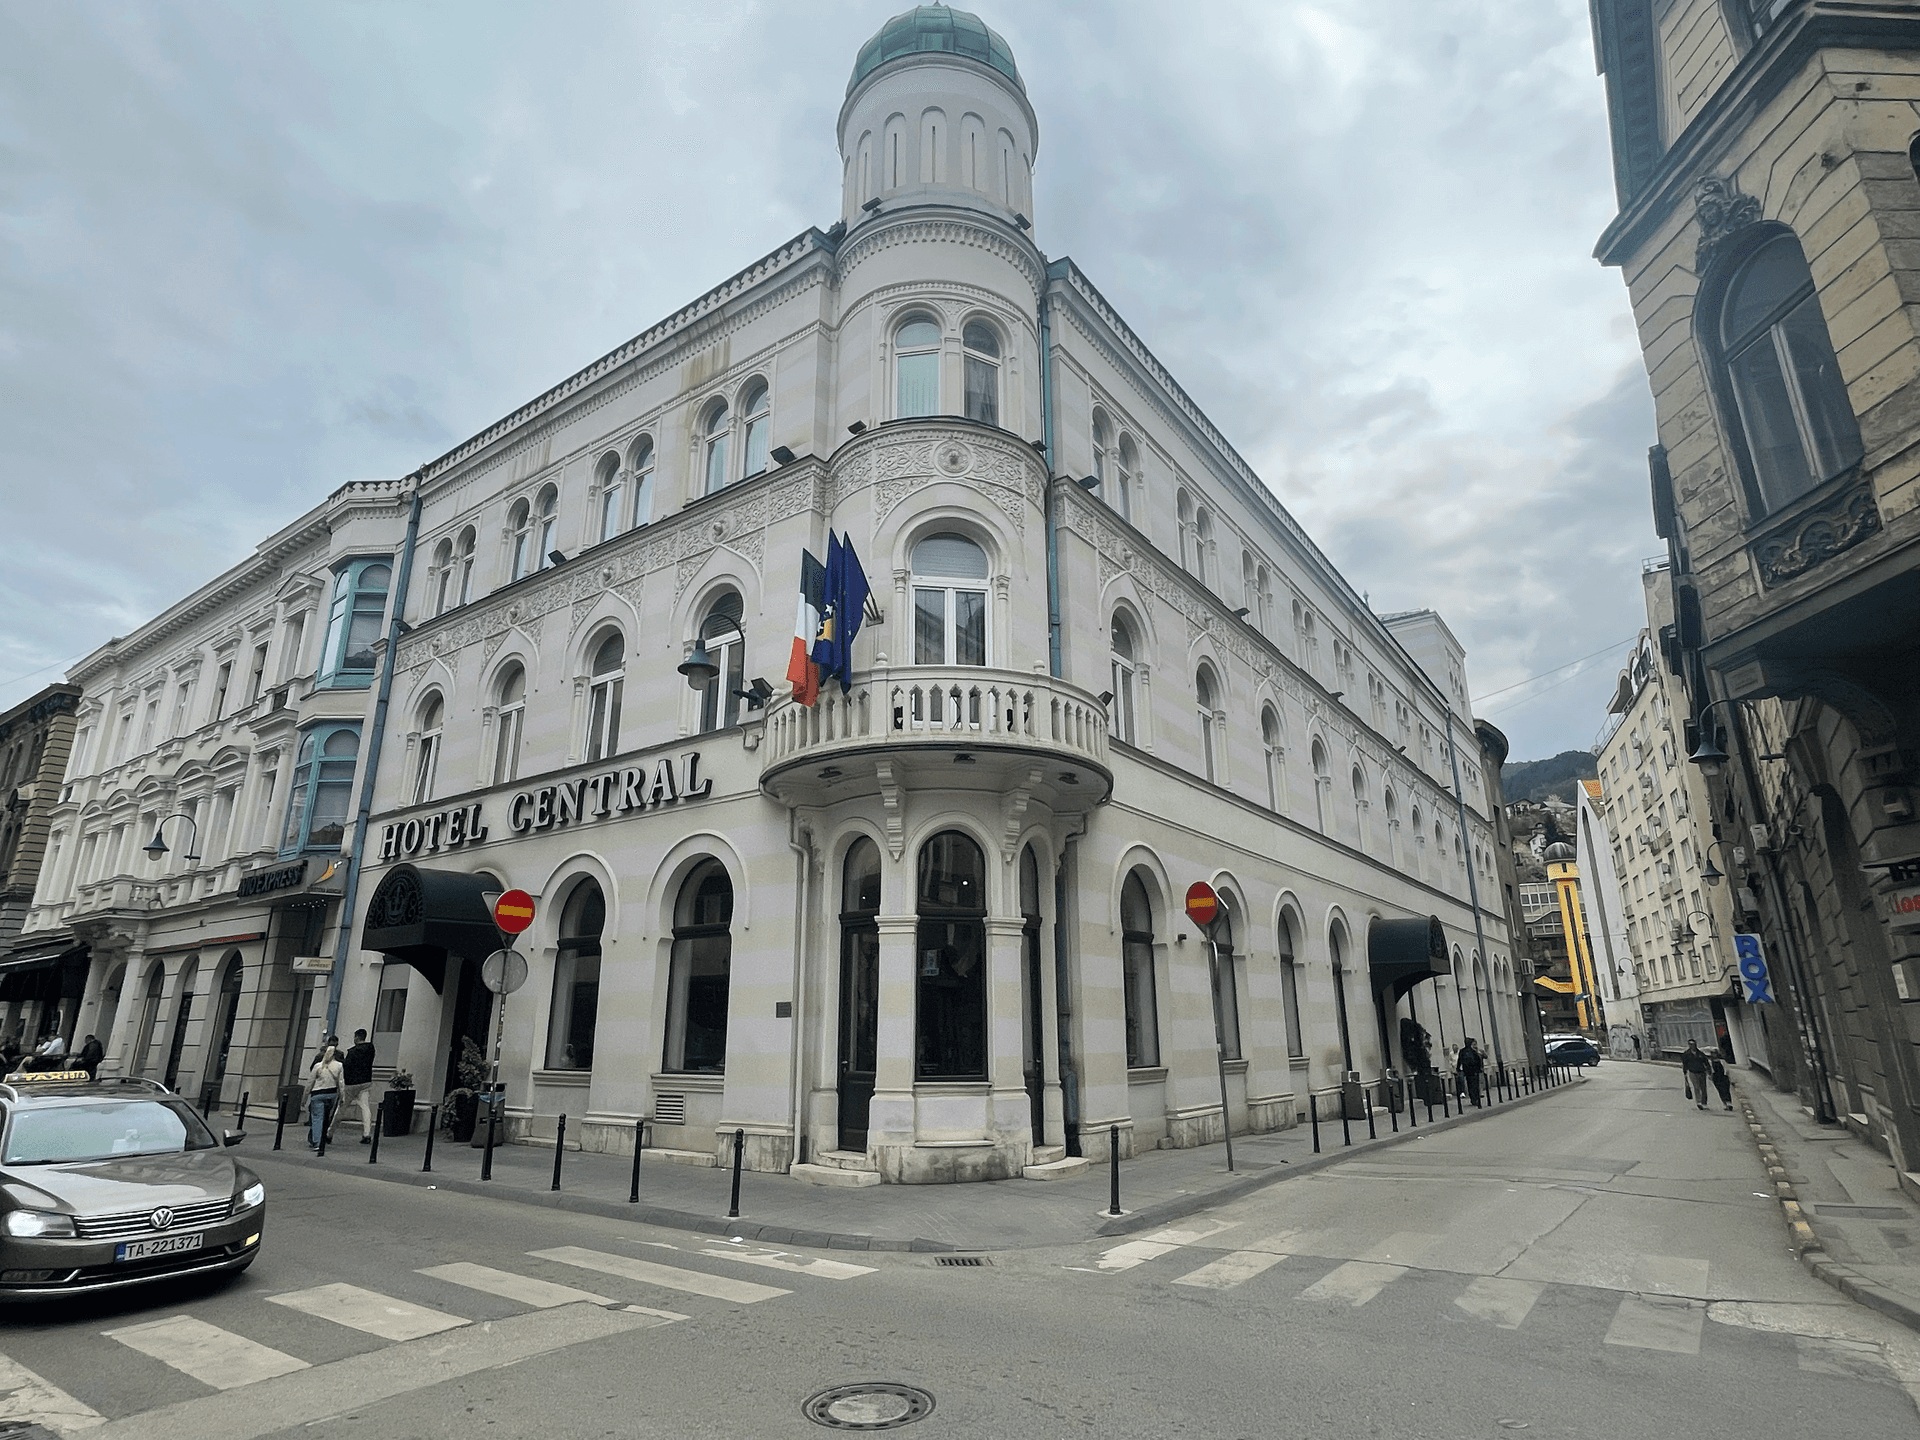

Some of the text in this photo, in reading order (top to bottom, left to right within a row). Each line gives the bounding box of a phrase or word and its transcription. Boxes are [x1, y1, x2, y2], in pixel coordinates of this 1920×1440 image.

[378, 752, 712, 859] HOTEL CENTRAL
[1734, 935, 1775, 1004] ROX
[25, 1071, 68, 1081] TAXI
[127, 1234, 201, 1257] TA-221371
